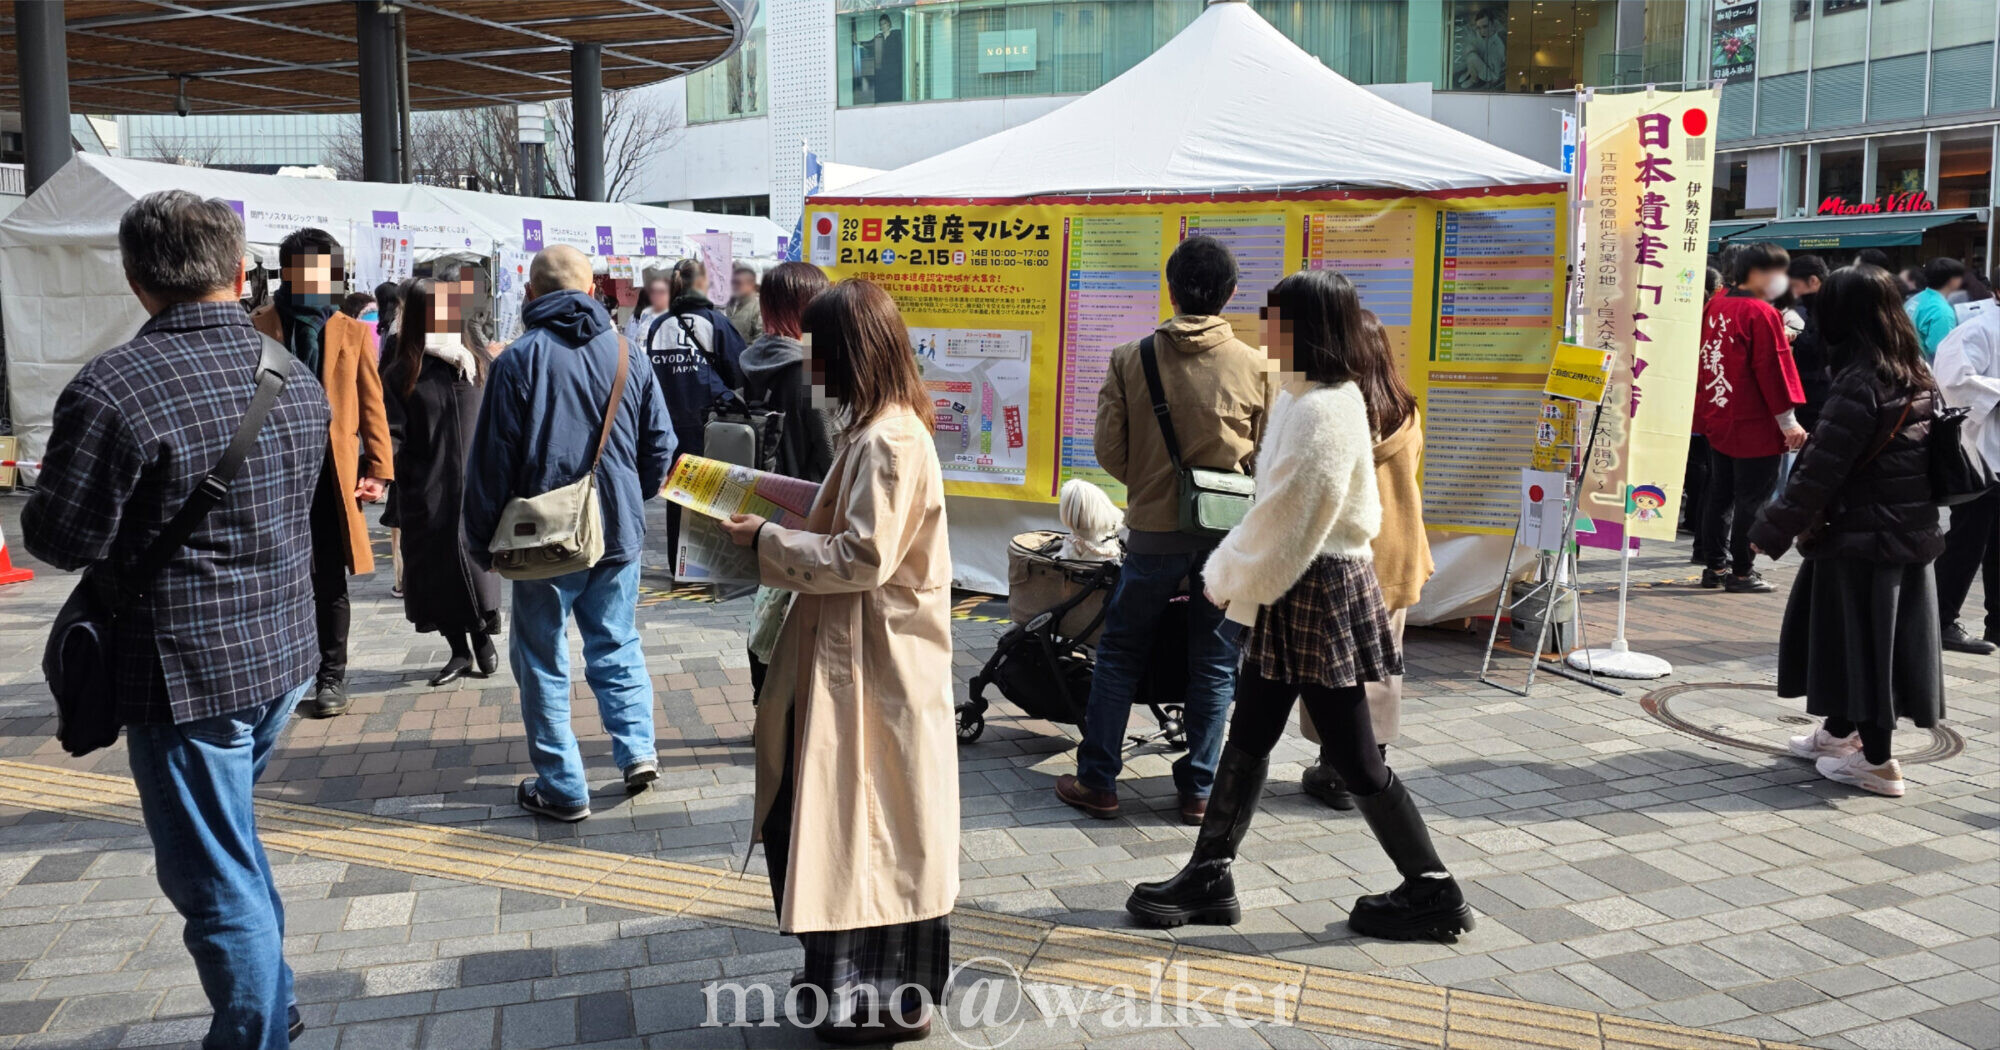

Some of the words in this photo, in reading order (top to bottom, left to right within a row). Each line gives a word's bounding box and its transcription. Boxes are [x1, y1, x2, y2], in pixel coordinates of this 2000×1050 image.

[987, 46, 1028, 56] NOBLE
[1817, 197, 1881, 215] Miami
[1886, 191, 1933, 213] Villa
[1600, 152, 1617, 286] 江戸庶民の信仰と行楽の地
[1682, 181, 1702, 253] 伊勢原市
[843, 218, 859, 230] 20
[862, 214, 1050, 243] 日本遺産マルシェ
[842, 230, 857, 241] 26
[970, 258, 988, 266] 15日
[651, 353, 692, 365] GYODA
[672, 365, 699, 374] JAPAN
